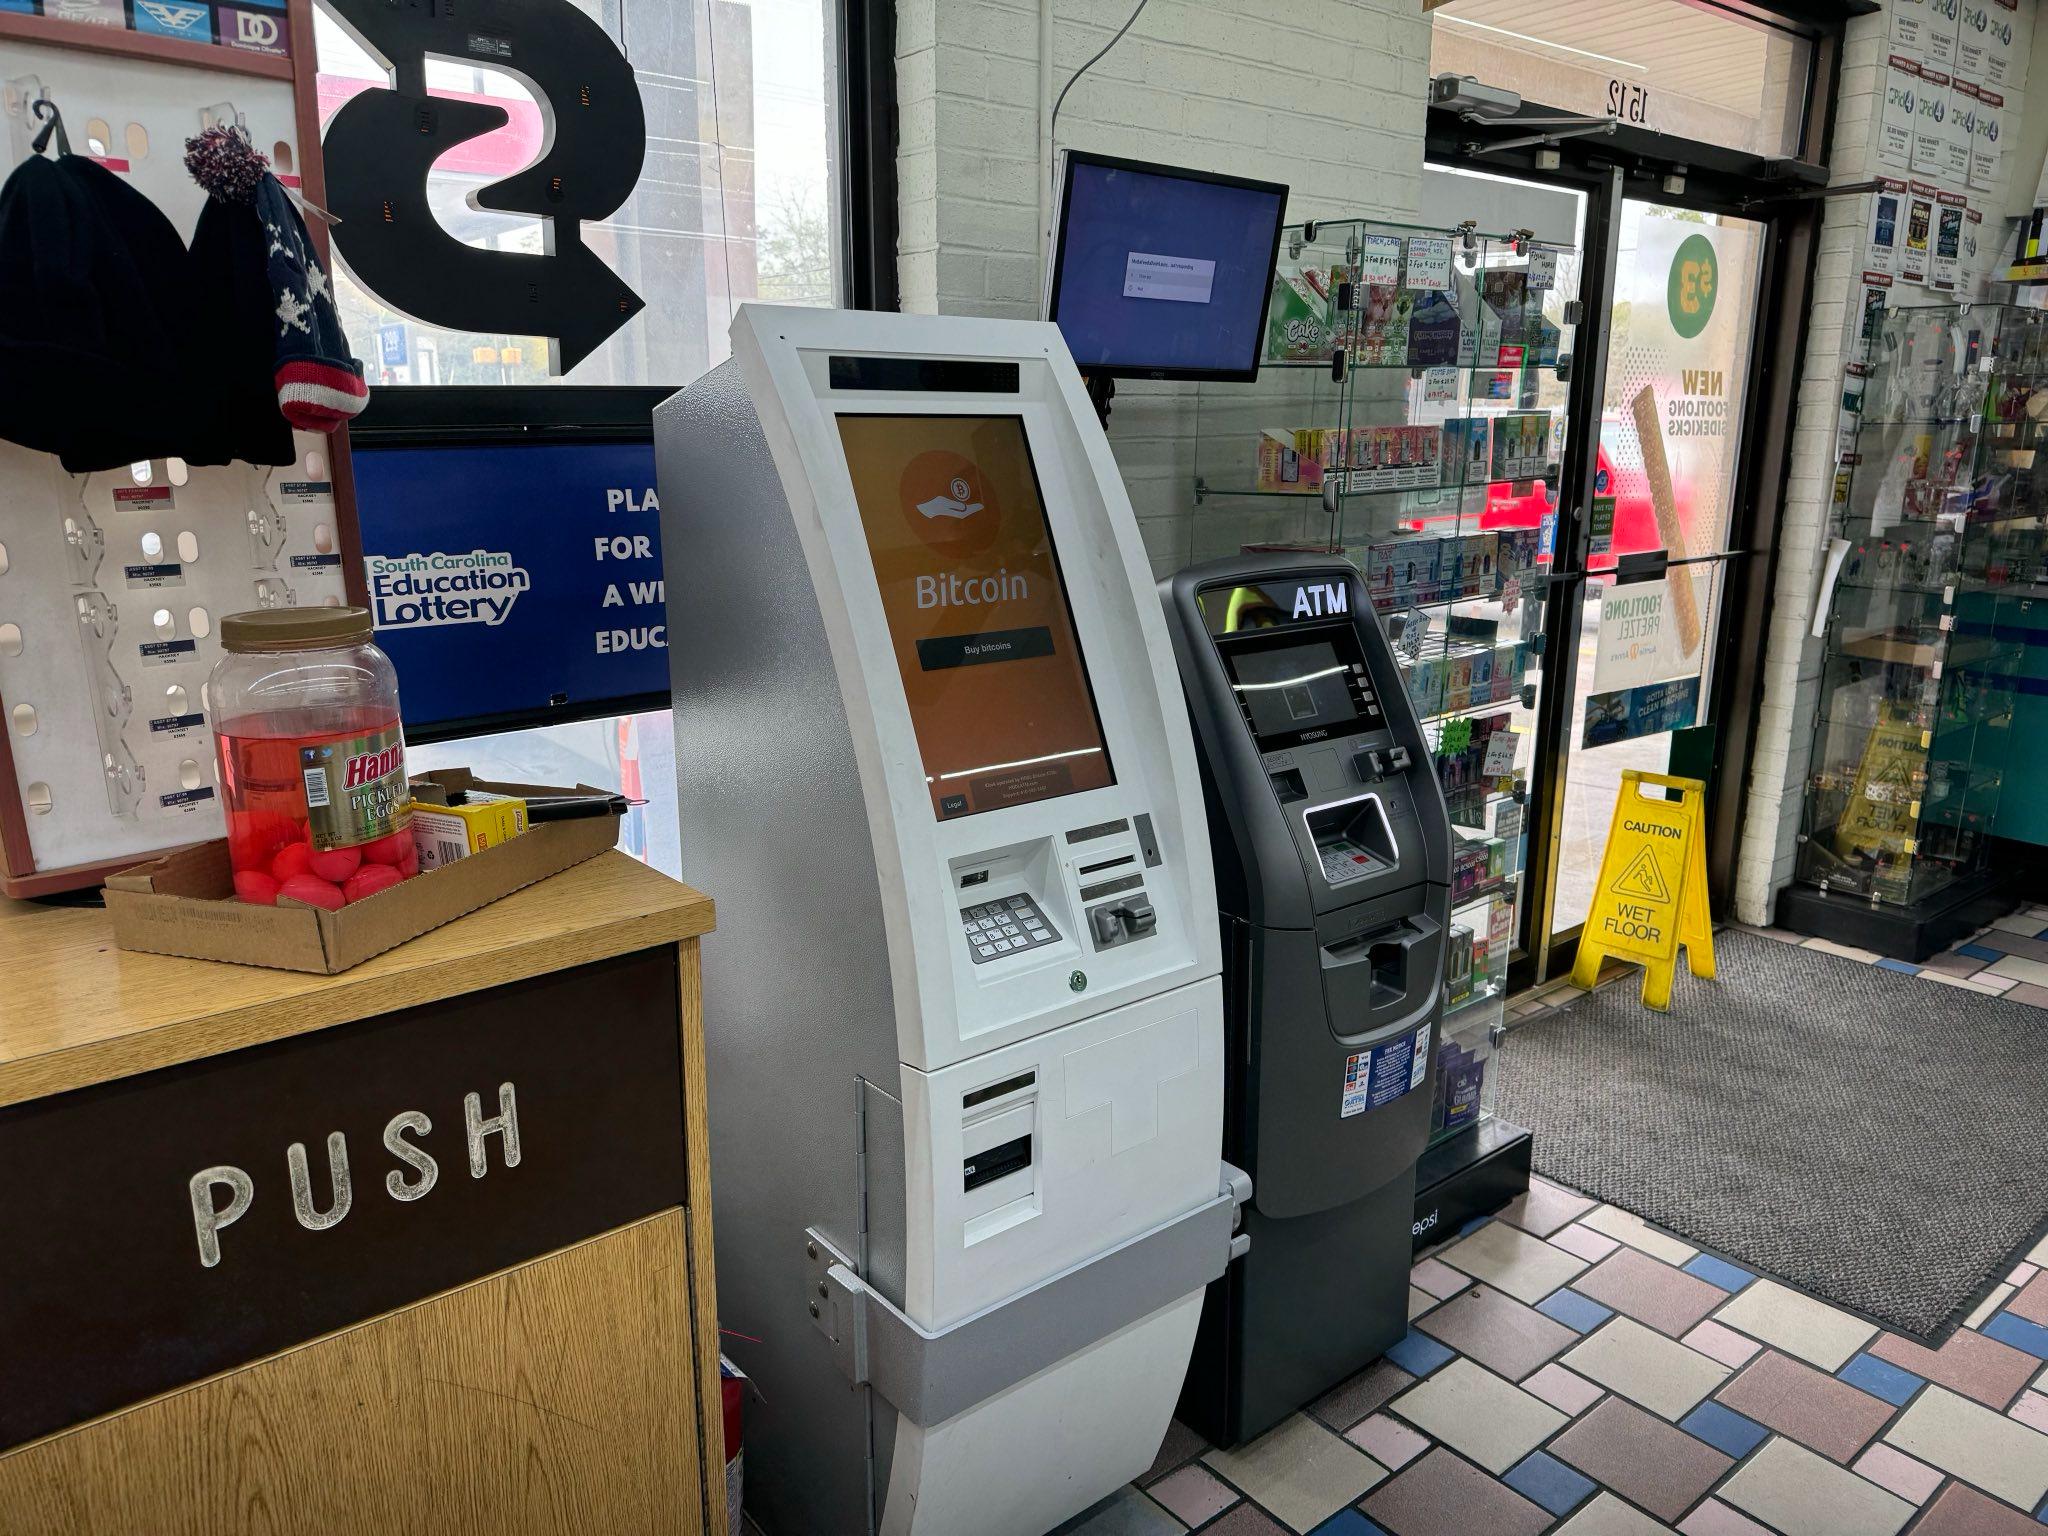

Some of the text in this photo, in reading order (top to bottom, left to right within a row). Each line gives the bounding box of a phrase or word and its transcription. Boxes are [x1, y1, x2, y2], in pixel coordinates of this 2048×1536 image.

[1284, 316, 1320, 342] Cake
[607, 488, 660, 513] PLA
[594, 535, 653, 561] FOR
[373, 553, 509, 574] South Carolina
[374, 568, 527, 598] Education
[602, 584, 624, 608] A
[916, 567, 1029, 611] Bitcoin
[376, 596, 512, 627] Lottery
[1293, 582, 1348, 619] ATM
[595, 625, 670, 654] EDUC
[964, 640, 1012, 656] Buy bitcoins
[1638, 702, 1660, 718] CLEAN
[352, 782, 405, 811] PICKLED
[946, 800, 963, 810] Legal
[366, 799, 400, 822] EGGS
[1624, 820, 1682, 840] CAUTION
[1618, 902, 1657, 921] WET
[1604, 917, 1662, 944] FLOOR
[189, 1081, 522, 1268] PUSH
[1412, 1209, 1439, 1237] epsi
